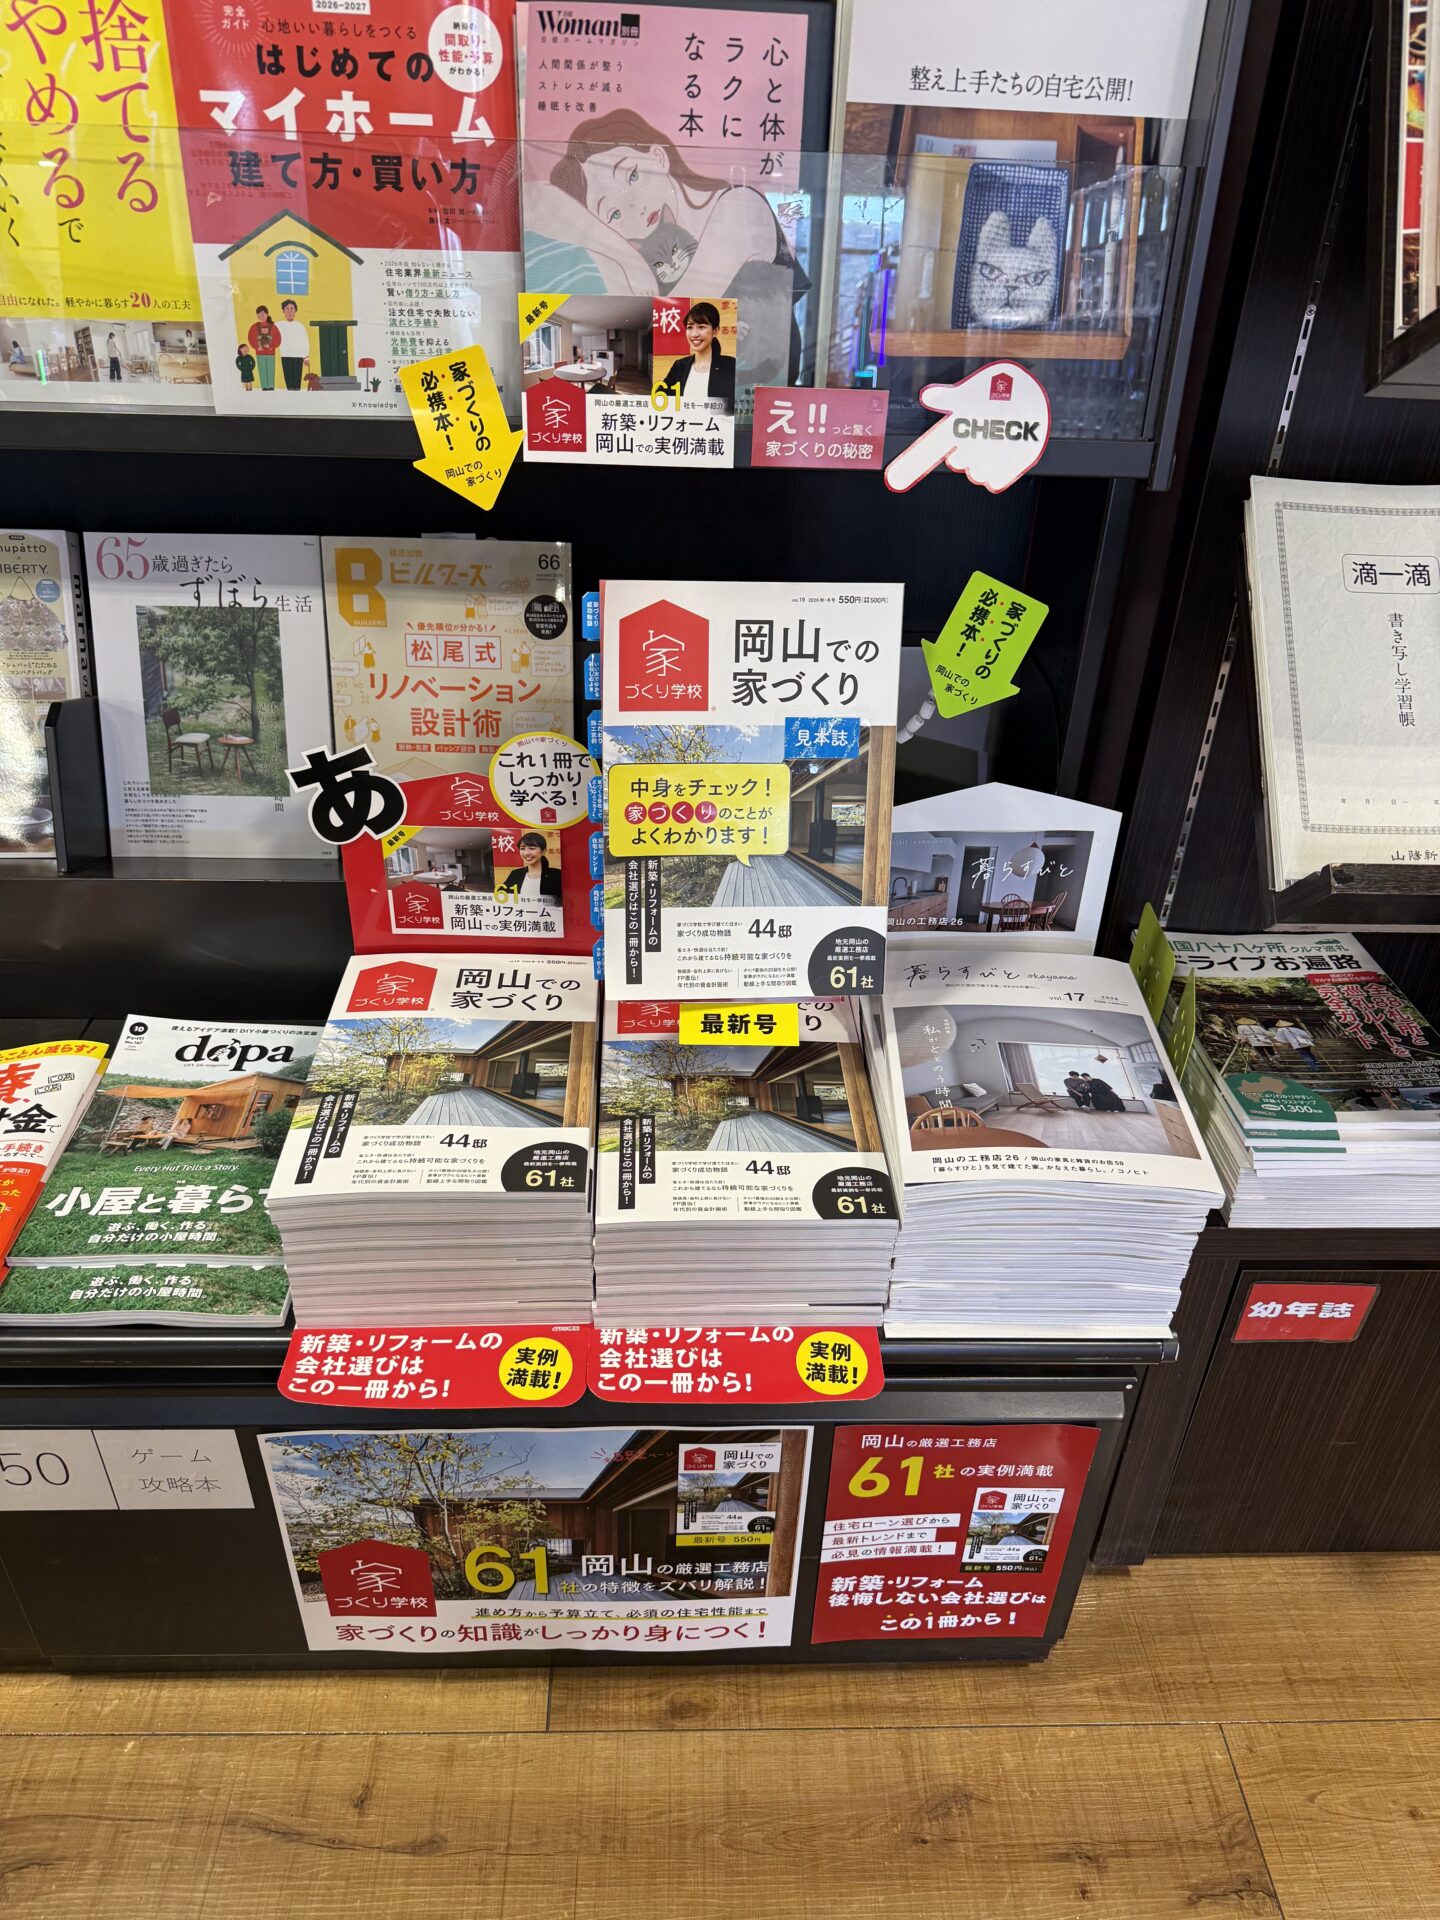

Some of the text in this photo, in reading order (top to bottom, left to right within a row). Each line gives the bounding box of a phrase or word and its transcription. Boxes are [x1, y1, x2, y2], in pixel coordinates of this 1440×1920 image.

[223, 5, 246, 17] 完全
[221, 19, 250, 30] ガイド
[262, 20, 417, 40] 心地いい暮らしをつくる
[537, 10, 640, 38] Woman 別冊
[257, 44, 434, 82] はじめての
[538, 58, 623, 72] 人間関係が整う
[538, 81, 623, 93] ストレスが減る
[678, 32, 705, 138] なる本
[722, 37, 744, 138] ラクに
[909, 65, 1135, 103] 整え上手たちの自宅公開!
[79, 0, 158, 213] 捨てる
[538, 101, 597, 113] 睡眠を改善
[759, 37, 788, 176] 心と体が
[200, 87, 495, 147] マイホーム
[229, 149, 481, 195] 建て方・買い方
[385, 269, 473, 278] 住宅業界最新ニュース
[388, 308, 475, 317] 注文住宅で失敗しない
[525, 300, 549, 326] 最新号
[391, 338, 449, 346] 光熱費を抑える
[351, 401, 399, 409] X-Knowledge
[651, 381, 681, 412] 61
[421, 371, 454, 451] 必携本!
[448, 361, 491, 452] 家づくりの
[601, 413, 720, 432] 新築・リフォーム
[832, 423, 873, 437] っと驚く
[953, 417, 1040, 441] CHECK
[531, 432, 583, 444] づくり学校
[595, 433, 725, 456] 岡山での実例満載
[765, 441, 873, 459] 家づくりの秘密
[445, 460, 483, 480] 岡山での
[466, 469, 502, 488] 家づくり
[96, 536, 233, 580] 65 歳過ぎたら
[538, 554, 561, 570] 66
[390, 562, 492, 587] ビルダーズ
[1352, 561, 1431, 587] 滴一滴
[179, 575, 312, 613] ずぼら 生活
[417, 623, 489, 632] 優先順位が分かる!
[956, 588, 999, 657] 必携本!
[734, 620, 879, 663] 岡山での
[975, 601, 1027, 680] 家づくりの
[411, 640, 497, 663] 松尾式
[936, 664, 970, 687] 岡山での
[1388, 612, 1415, 728] 書き写し学習帳
[368, 673, 541, 704] リノベーション
[625, 683, 702, 700] づくり学校
[731, 669, 859, 706] 家づくり
[944, 683, 978, 705] 家づくり
[410, 707, 502, 738] 設計術
[796, 729, 848, 747] 見本誌
[498, 752, 591, 769] これ1冊で
[509, 771, 582, 787] しっかり
[630, 778, 771, 798] 中身をチェック!
[291, 748, 404, 842] あ
[510, 790, 578, 806] 学べる!
[440, 811, 499, 822] づくり学校
[627, 803, 772, 822] 家づくりのことが
[631, 827, 767, 845] よくわかります!
[971, 857, 1074, 889] 暮らすびと
[494, 884, 519, 904] 61
[648, 860, 658, 945] 新築・リフォームの
[398, 916, 440, 924] づくり学校
[455, 904, 552, 917] 新築・リフォーム
[628, 860, 639, 978] 会社選びはこの一冊から!
[451, 917, 556, 932] 岡山での実例満載
[748, 919, 792, 938] 44邸
[1289, 945, 1349, 953] クルマ巡礼
[455, 968, 580, 991] 岡山での
[830, 966, 874, 989] 61社
[904, 964, 1019, 987] 暮らすびと
[1028, 973, 1077, 981] okayama
[354, 996, 425, 1007] づくり学校
[449, 992, 563, 1011] 家づくり
[1049, 992, 1085, 1002] vol.17
[623, 1019, 679, 1028] づくり学
[701, 1013, 777, 1035] 最新号
[1317, 984, 1377, 1049] 完全ガイド
[1366, 984, 1429, 1045] 全88札所と
[175, 1034, 294, 1071] dopa
[440, 1134, 488, 1148] 44邸
[642, 1118, 653, 1178] 新築・リフォームの
[745, 1160, 791, 1175] 44邸
[932, 1154, 1019, 1164] 岡山の工務店26
[134, 1165, 159, 1173] Every
[213, 1165, 240, 1173] Story.
[525, 1169, 575, 1187] 61社
[837, 1196, 887, 1214] 61社
[88, 1232, 223, 1243] 自分だけの小屋時間。
[89, 1275, 198, 1287] 遊ぶ、働く、作る。
[69, 1287, 208, 1300] 自分だけの小屋時間。
[1248, 1301, 1354, 1318] 幼年誌
[301, 1332, 502, 1353] 新築・リフォームの
[600, 1328, 794, 1344] 新築・リフォームの
[295, 1348, 557, 1375] 会社選びは 実例
[600, 1342, 851, 1368] 会社選びは 実例
[287, 1368, 560, 1397] この一冊から! 満載!
[598, 1361, 858, 1392] この一冊から! 満載!
[861, 1434, 998, 1449] 岡山の厳選工務店
[132, 1449, 211, 1464] ゲーム
[724, 1450, 773, 1460] 岡山での
[723, 1461, 766, 1469] 家づくり
[138, 1476, 222, 1493] 攻略本
[848, 1456, 1053, 1498] 61 社の実例満載
[1013, 1494, 1056, 1502] 岡山での
[833, 1516, 950, 1531] 住宅ローン選びから
[832, 1531, 927, 1545] 最新トレンドまで
[831, 1544, 943, 1559] 必見の情報満載!
[465, 1546, 769, 1594] 61 岡山の厳選工務店
[559, 1578, 766, 1594] 社の特徴をズバリ解説!
[831, 1575, 983, 1592] 新築・リフォーム
[335, 1596, 428, 1610] づくり学校
[829, 1592, 1046, 1606] 後悔しない会社選びは
[475, 1605, 767, 1619] 進め方から予算立て、必須の住宅性能まで
[880, 1612, 1015, 1631] この1冊から!
[335, 1622, 767, 1642] 家づくりの知識がしっかり身につく!
